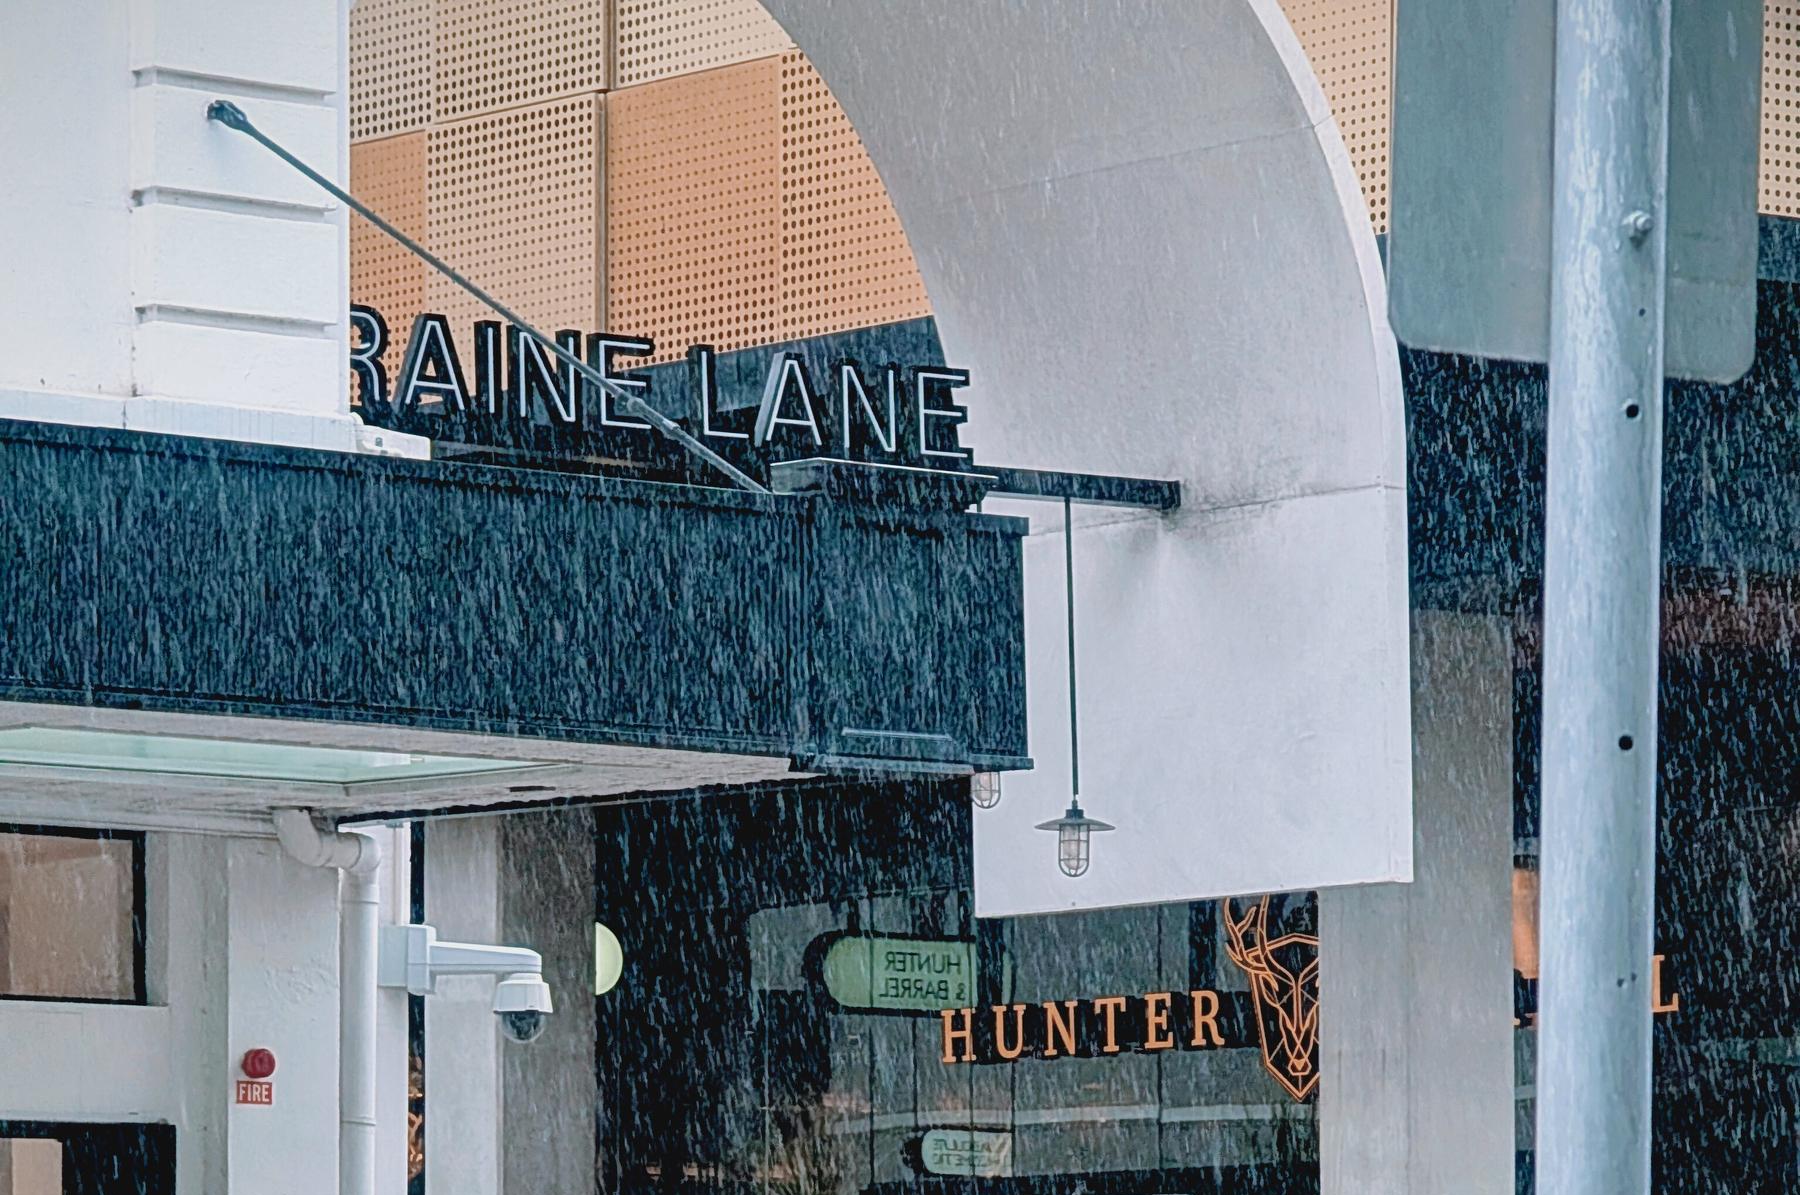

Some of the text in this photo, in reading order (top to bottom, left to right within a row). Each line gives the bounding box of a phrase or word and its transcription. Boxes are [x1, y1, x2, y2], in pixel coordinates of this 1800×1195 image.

[350, 306, 969, 460] RAINE LANE
[941, 990, 1225, 1064] HUNTER
[239, 1083, 270, 1103] FIRE
